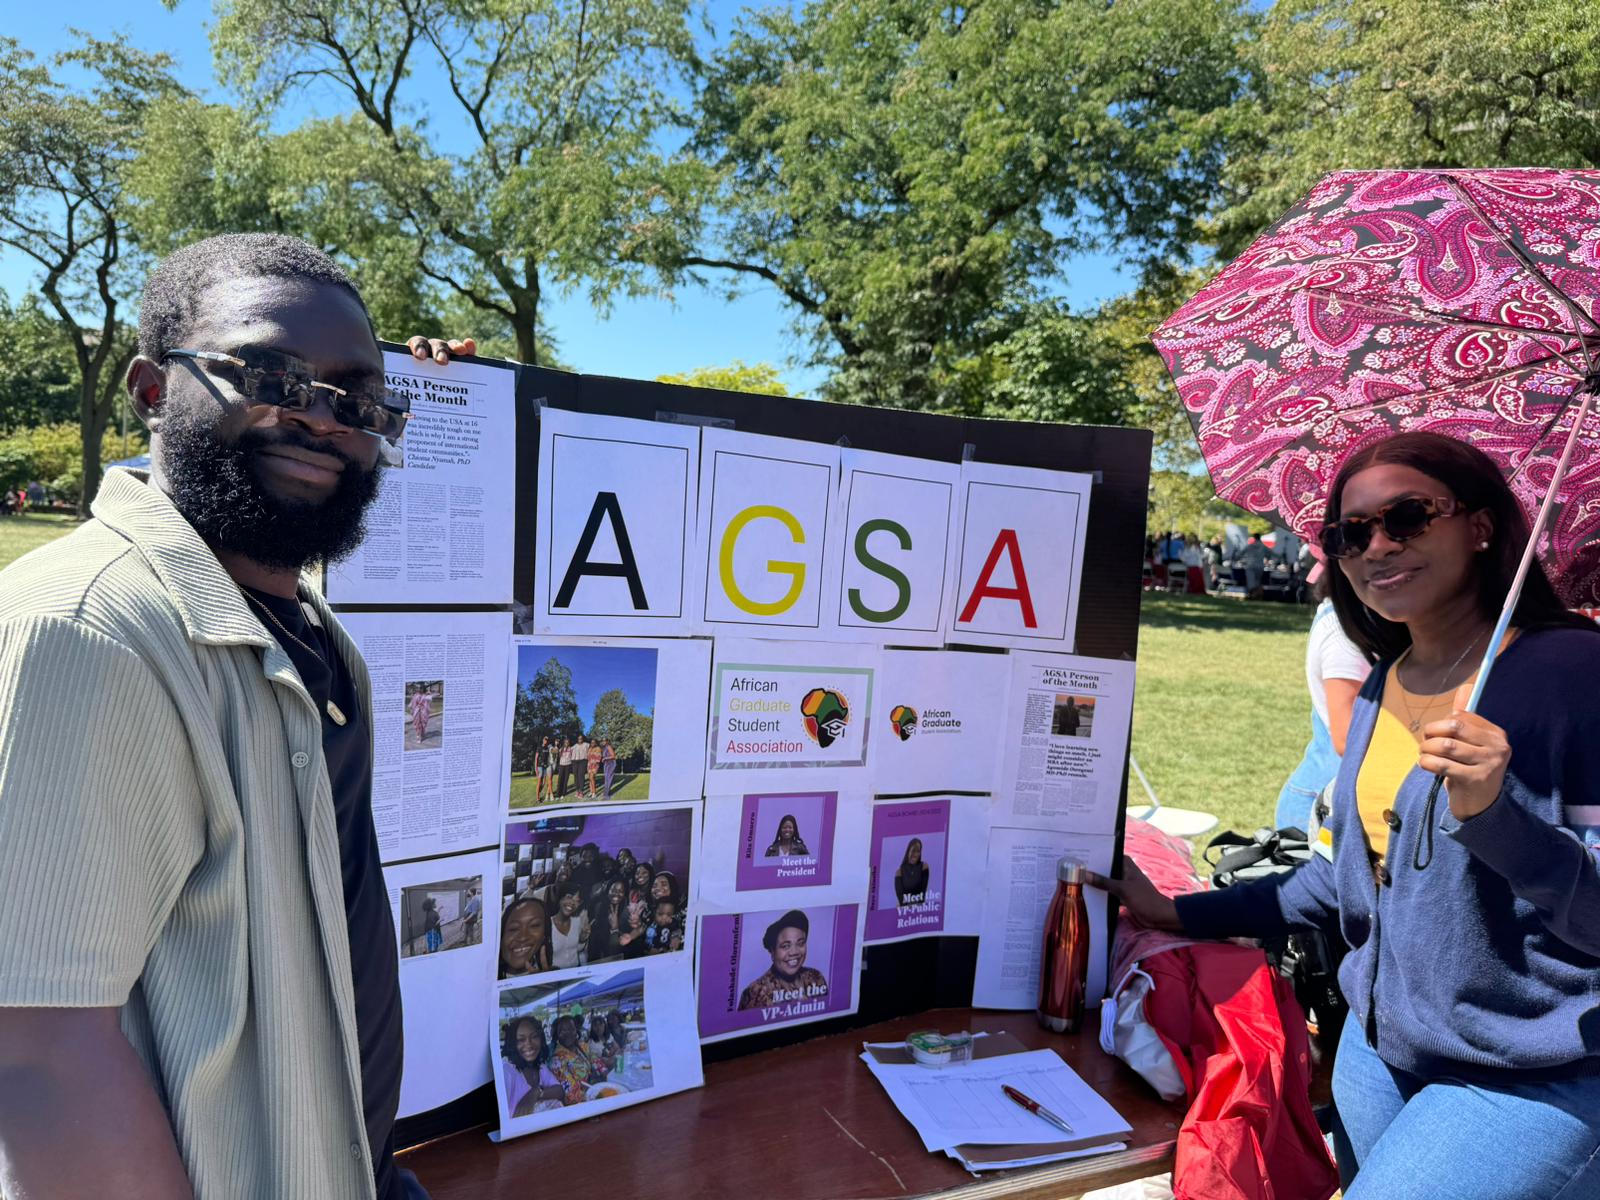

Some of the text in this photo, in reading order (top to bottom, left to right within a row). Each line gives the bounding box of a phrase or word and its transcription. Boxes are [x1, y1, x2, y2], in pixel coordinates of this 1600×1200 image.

[423, 380, 469, 395] Person
[424, 392, 468, 406] Month
[437, 416, 448, 424] the
[449, 418, 463, 426] USA
[1042, 669, 1100, 681] AGSA Person
[730, 676, 779, 693] African
[1042, 677, 1054, 685] of
[1053, 678, 1068, 687] the
[1069, 679, 1098, 690] Month
[728, 698, 792, 714] Graduate
[922, 709, 952, 719] African
[727, 717, 780, 733] Student
[921, 718, 962, 728] Graduate
[726, 739, 803, 754] Association
[782, 856, 817, 867] Meet the
[776, 866, 816, 877] President
[902, 889, 941, 904] Meet the
[896, 900, 940, 916] VP-Public
[897, 914, 940, 929] Relations
[772, 982, 828, 1003] Meet the
[760, 998, 826, 1021] VP-Admin
